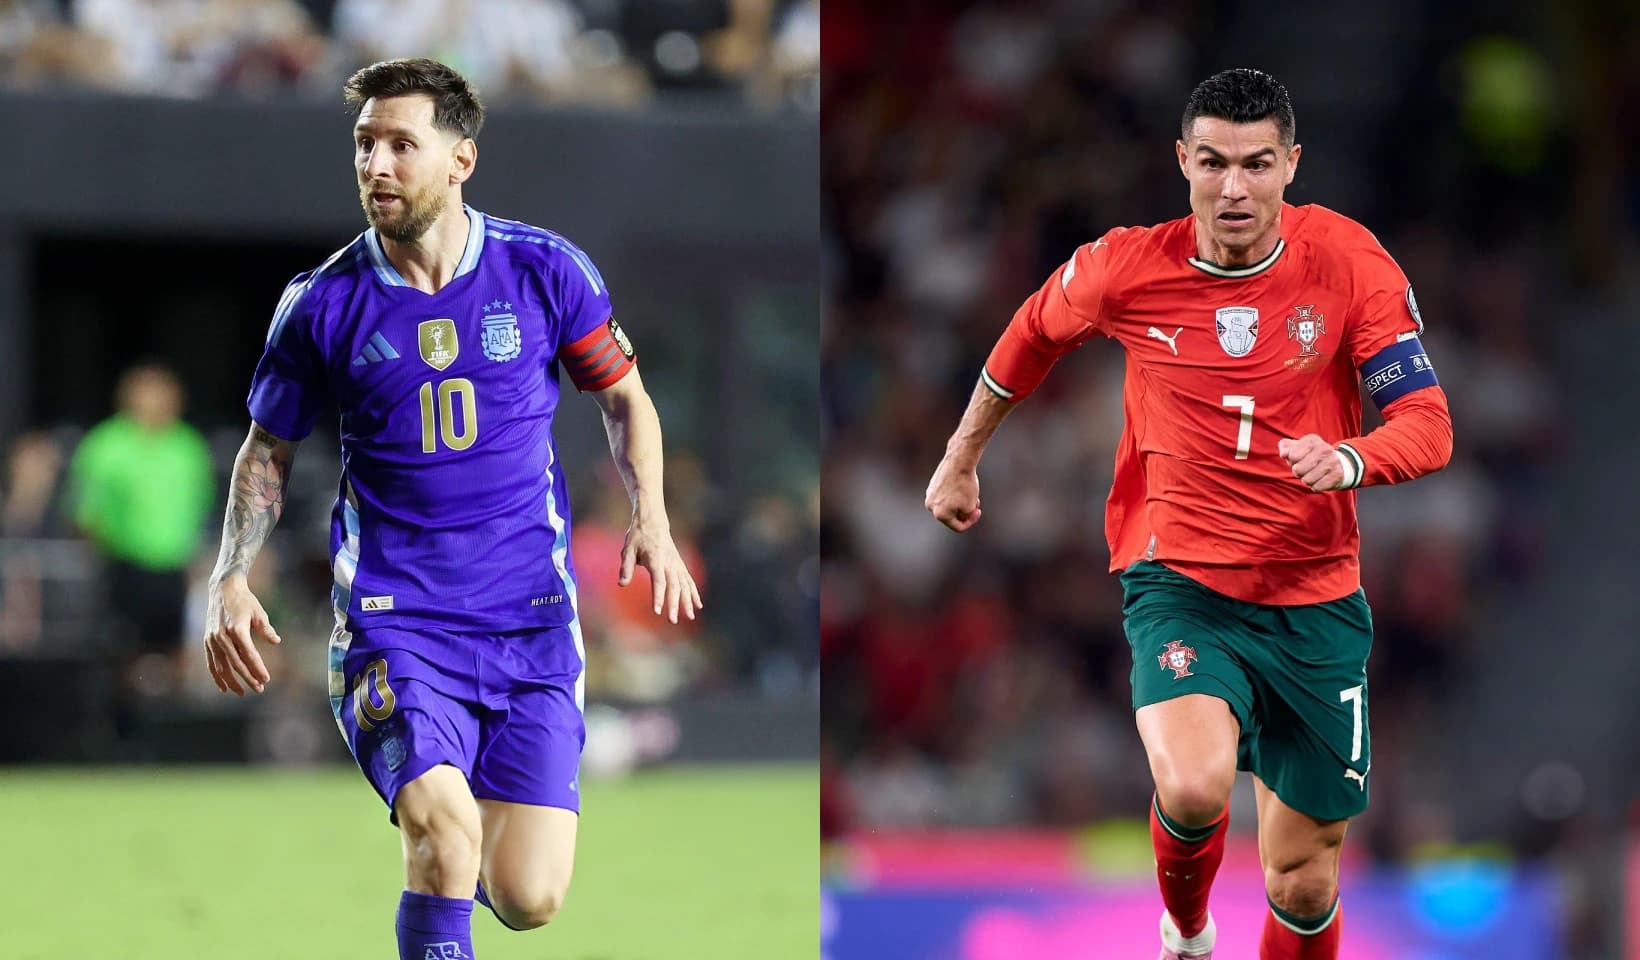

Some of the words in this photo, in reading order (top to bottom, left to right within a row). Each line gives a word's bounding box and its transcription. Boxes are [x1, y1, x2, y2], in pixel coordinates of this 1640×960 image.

[1366, 364, 1403, 392] ESPECT
[419, 378, 478, 453] 10
[1222, 395, 1255, 460] 7
[353, 658, 396, 732] 10
[1340, 684, 1364, 762] 7
